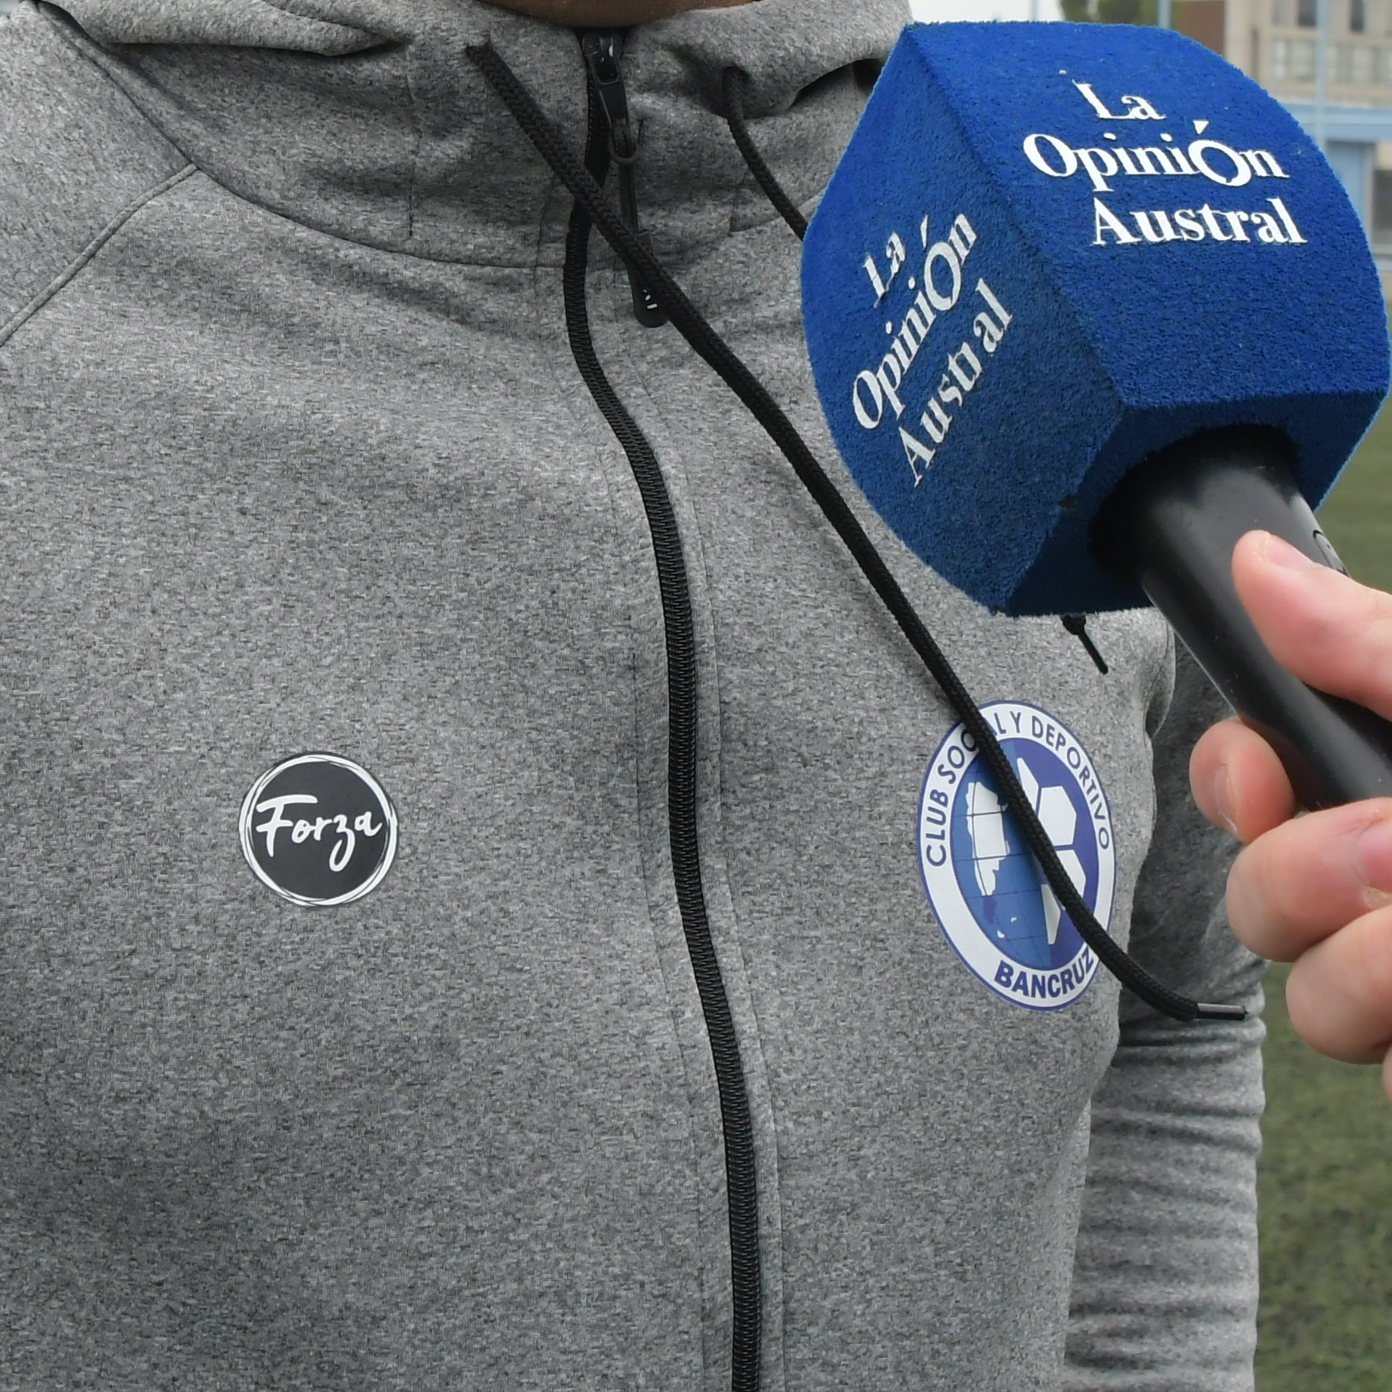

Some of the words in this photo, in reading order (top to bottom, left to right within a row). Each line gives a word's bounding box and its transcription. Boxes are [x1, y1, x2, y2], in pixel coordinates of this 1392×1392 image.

[1073, 80, 1166, 121] La
[1092, 197, 1308, 246] Austral
[861, 230, 906, 306] La
[937, 711, 1007, 785] SOCL
[1009, 710, 1022, 734] Y
[1031, 715, 1110, 850] DEPORTIVO
[256, 794, 383, 872] Forza
[926, 788, 950, 867] CLUB
[993, 945, 1095, 999] BANCRUZ
